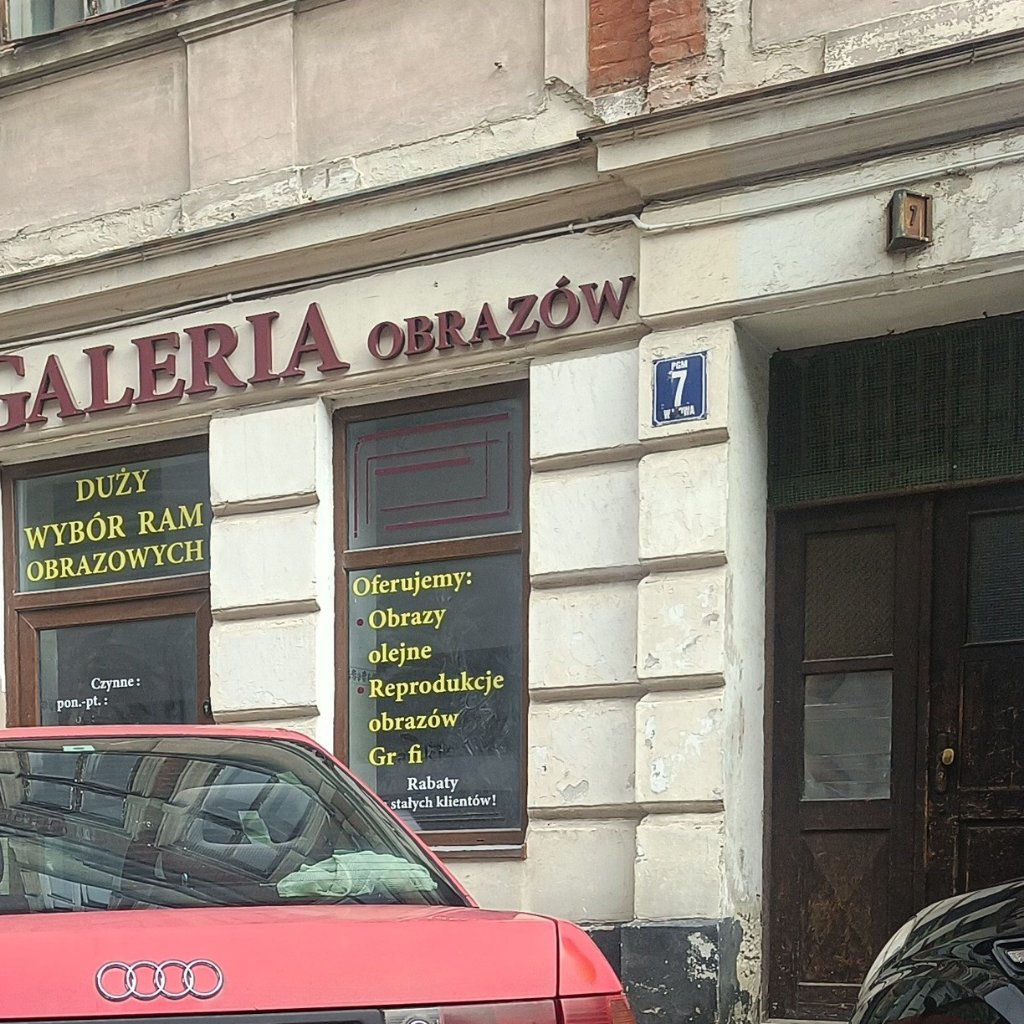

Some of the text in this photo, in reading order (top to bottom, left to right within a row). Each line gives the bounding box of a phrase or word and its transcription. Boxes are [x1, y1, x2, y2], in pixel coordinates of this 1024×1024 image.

[909, 205, 918, 226] 7
[367, 275, 636, 360] OBRAZÓW
[671, 369, 688, 407] 7
[76, 467, 149, 502] DUŻY
[24, 502, 204, 550] WYBÓR RAM
[26, 539, 204, 582] OBRAZOWYCH
[352, 571, 472, 596] Oferujemy:
[368, 607, 447, 629] Obrazy
[368, 642, 432, 667] olejne
[91, 677, 134, 691] Czynne
[369, 670, 505, 702] Reprodukcje
[368, 708, 459, 732] obrazów
[407, 776, 459, 793] Rabaty
[391, 797, 433, 812] stałych
